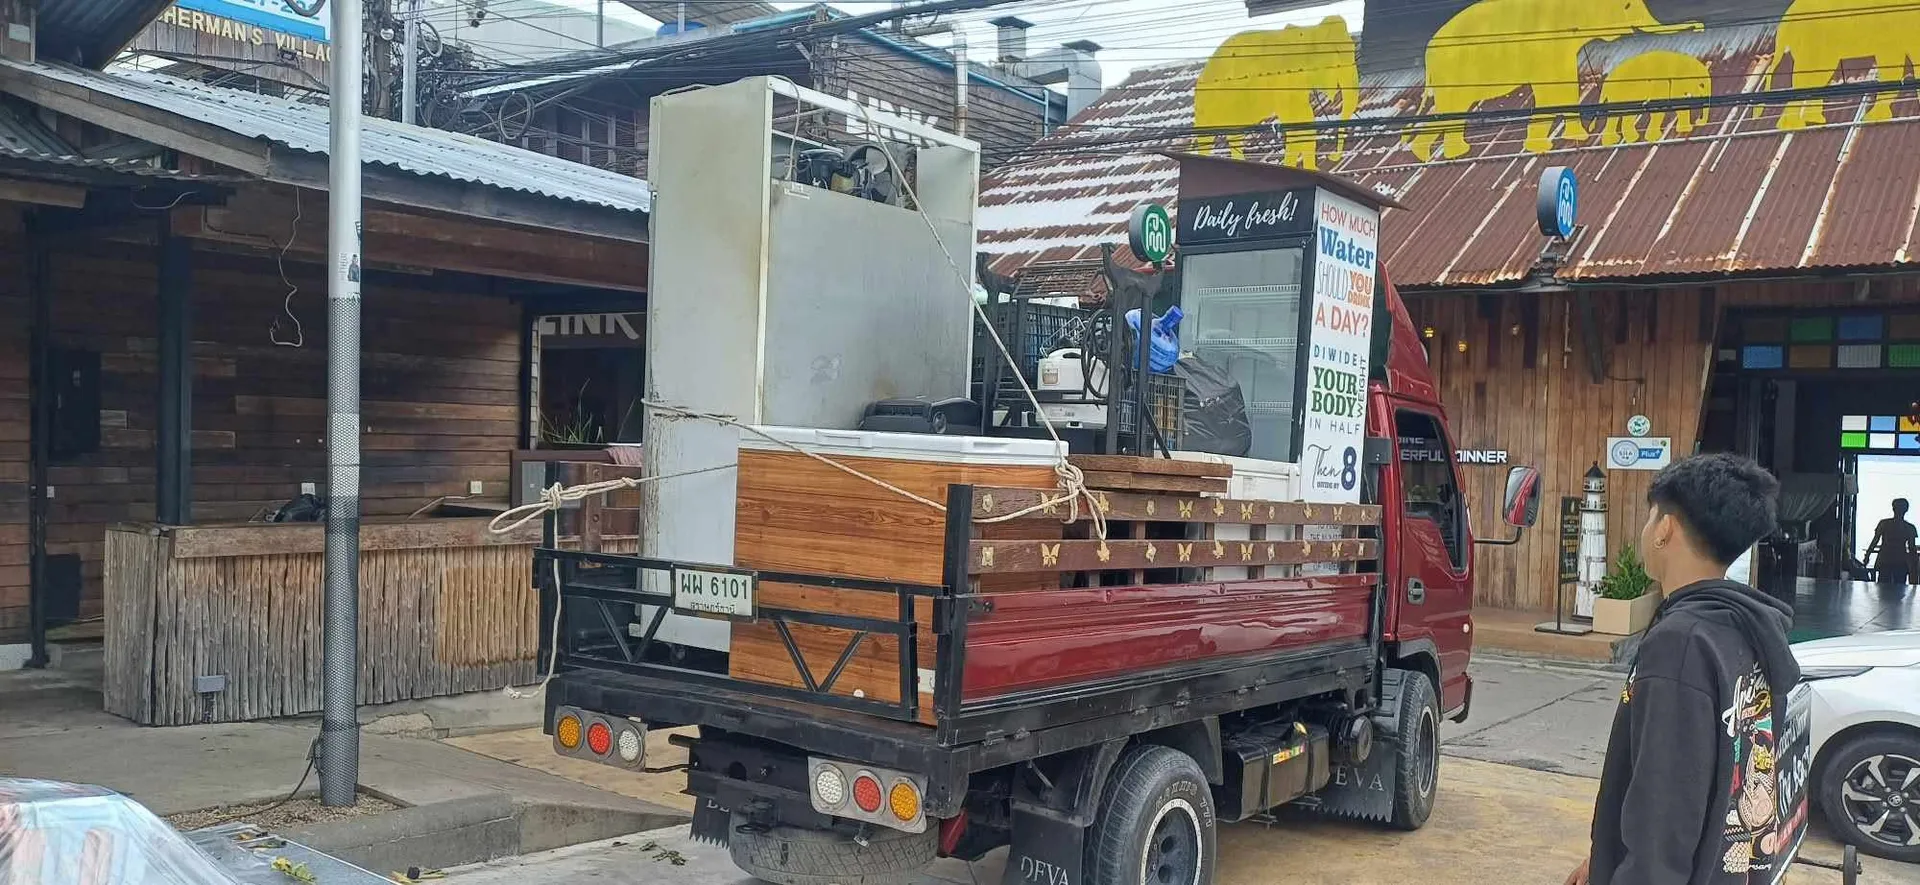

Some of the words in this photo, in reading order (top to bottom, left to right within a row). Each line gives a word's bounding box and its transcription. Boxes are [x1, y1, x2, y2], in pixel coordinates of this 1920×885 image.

[1193, 201, 1244, 237] Daily
[1244, 191, 1299, 230] fresh!
[1321, 202, 1347, 227] HOW
[1349, 213, 1376, 239] MUCH
[1319, 226, 1374, 270] Water
[1316, 260, 1349, 301] SHOULD
[1350, 270, 1373, 295] YOU
[1347, 290, 1371, 309] DRINK
[1314, 302, 1326, 328] A
[1331, 304, 1369, 338] DAY?
[1313, 344, 1358, 366] DIWIDE
[1313, 366, 1358, 396] YOUR
[1357, 355, 1367, 418] WEIGHT
[1311, 390, 1358, 418] BODY
[1309, 417, 1321, 430] IN
[1329, 421, 1360, 436] HALF
[1307, 443, 1341, 489] Then
[1341, 446, 1357, 491] 8
[710, 576, 747, 600] 6101
